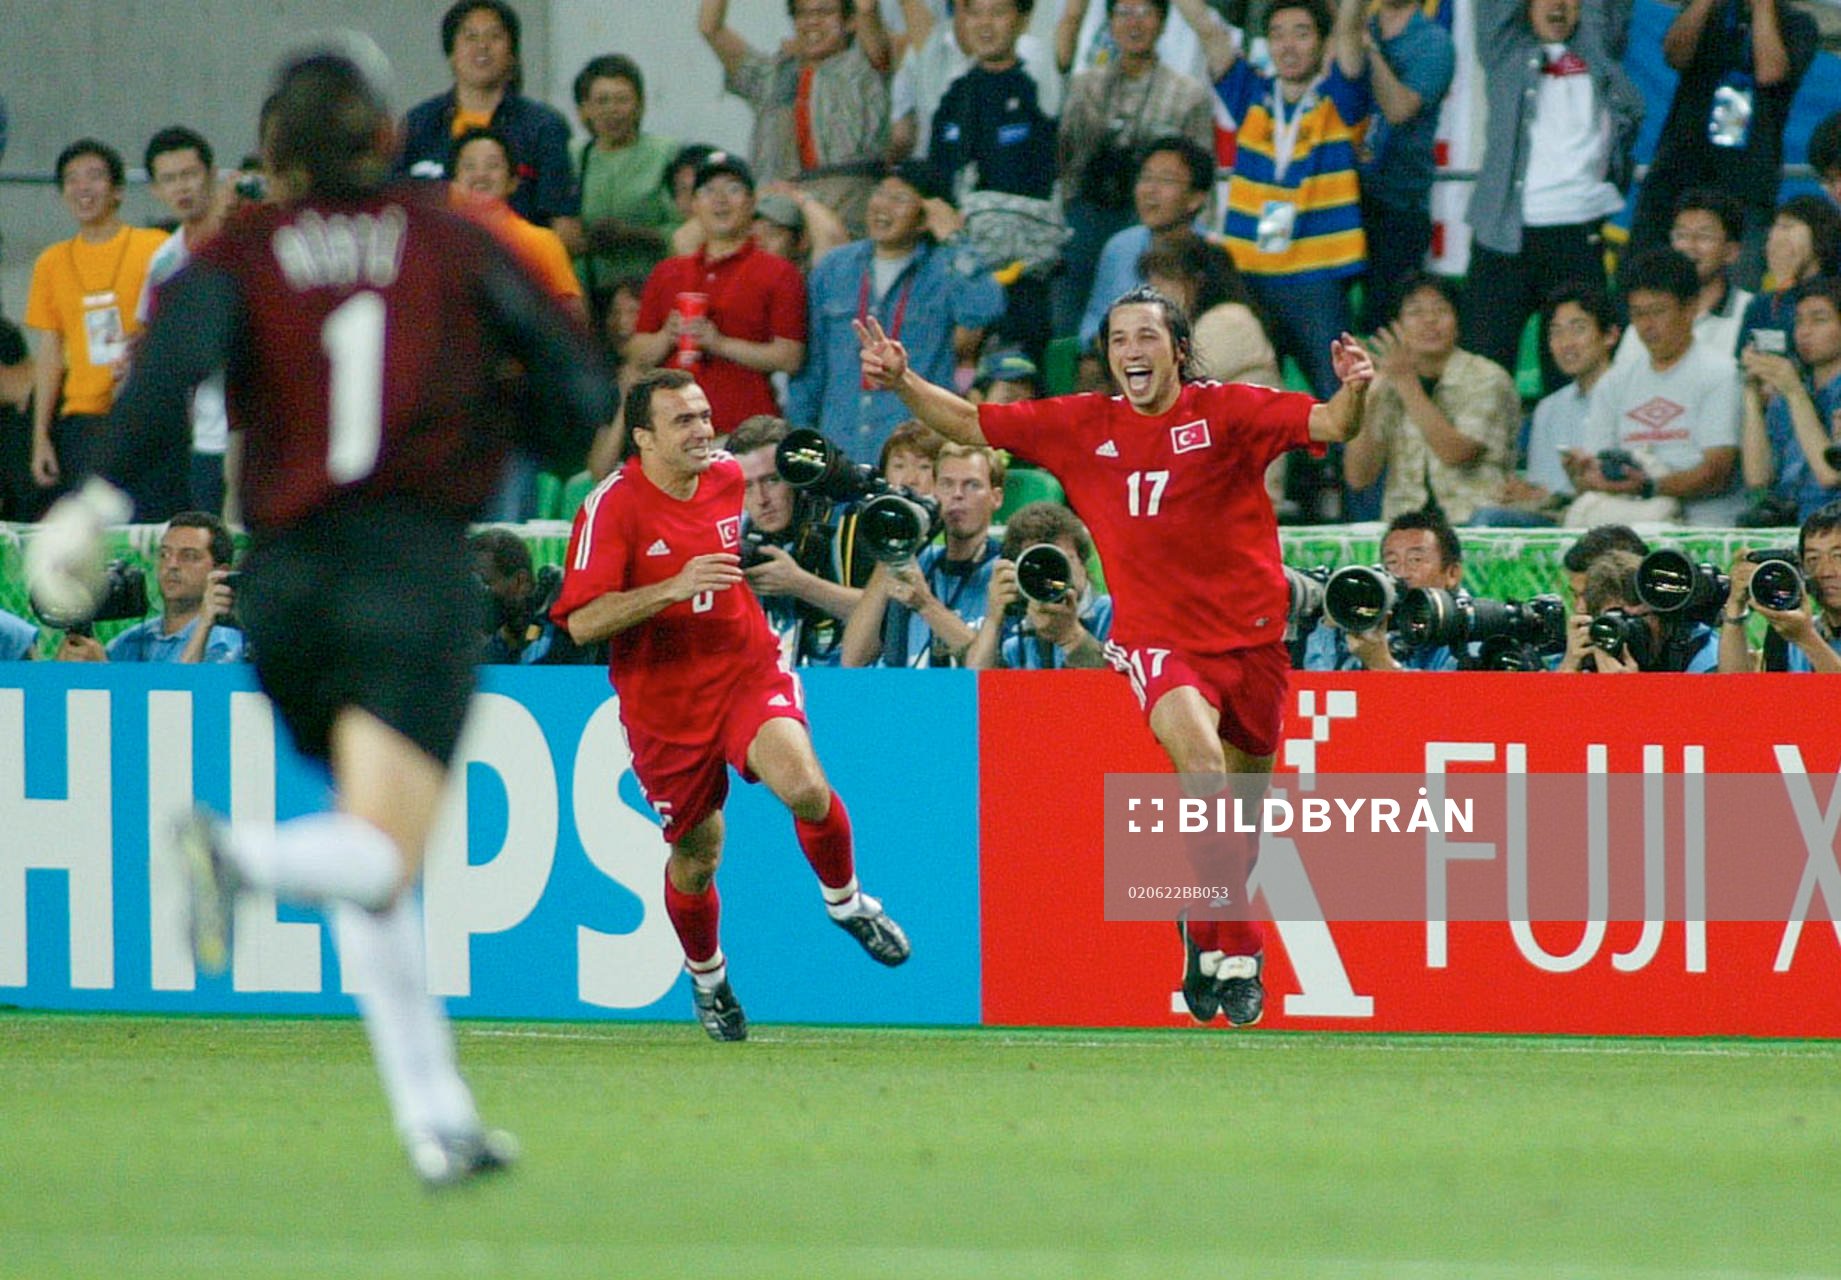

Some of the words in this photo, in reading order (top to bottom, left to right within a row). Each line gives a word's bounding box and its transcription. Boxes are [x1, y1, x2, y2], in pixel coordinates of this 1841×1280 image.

[322, 290, 386, 484] 1
[1127, 471, 1169, 516] 17
[1130, 648, 1171, 686] 17
[0, 688, 687, 1008] HILPS
[1425, 742, 1707, 972] FUJI
